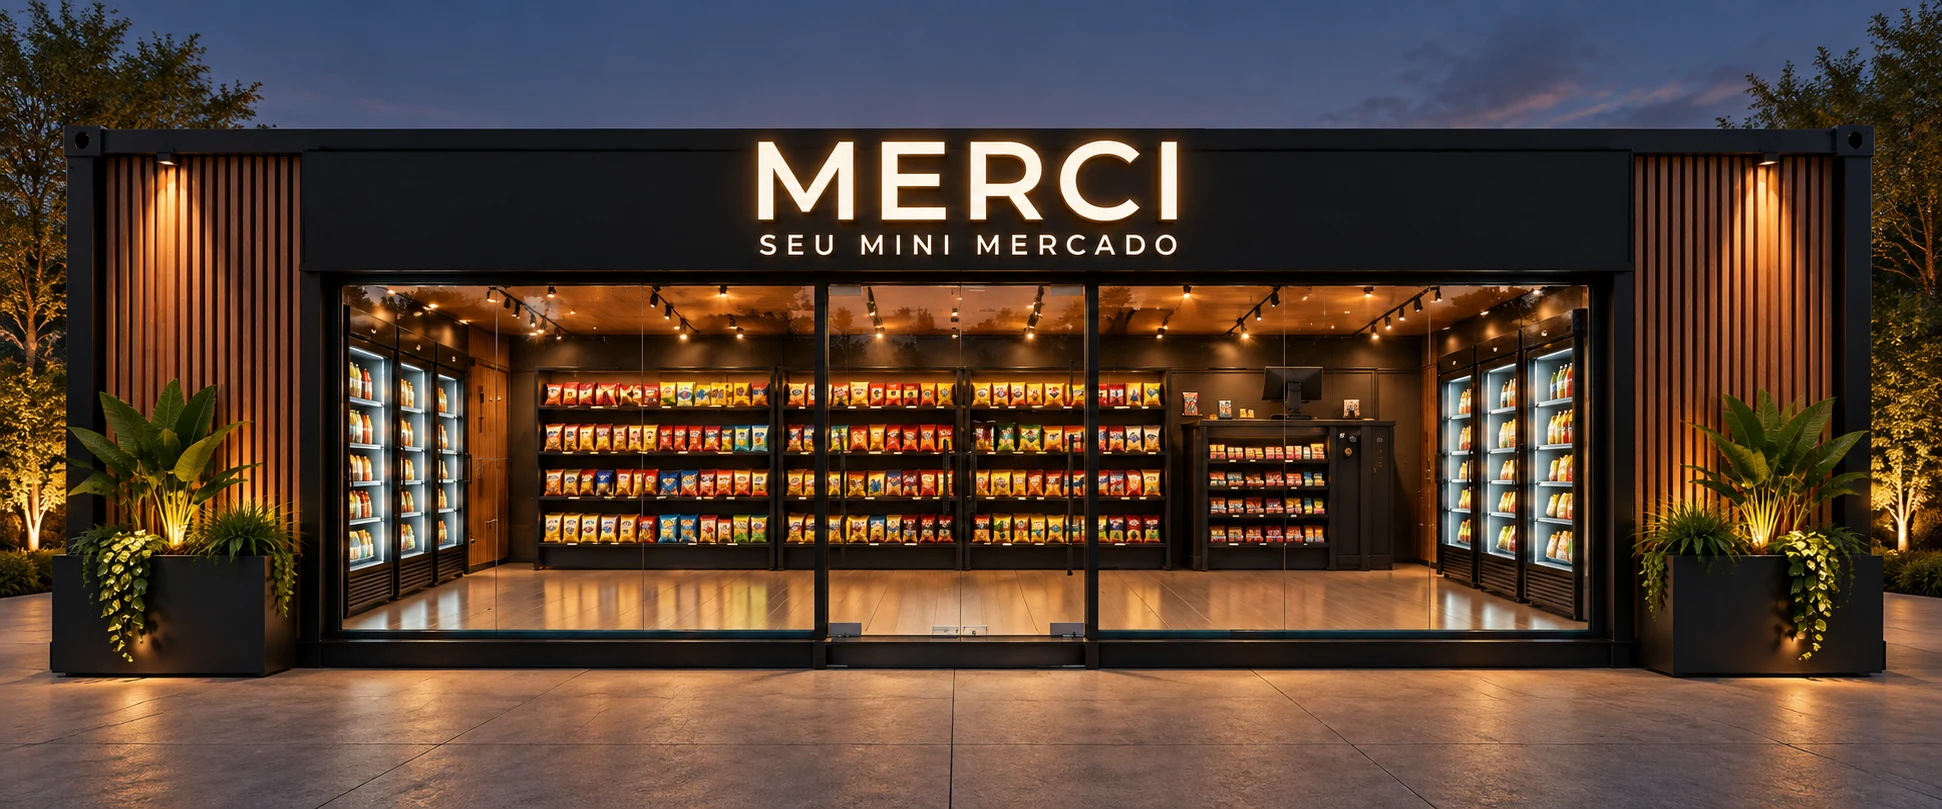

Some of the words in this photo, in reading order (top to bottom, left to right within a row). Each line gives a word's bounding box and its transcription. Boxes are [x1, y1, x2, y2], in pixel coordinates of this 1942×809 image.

[757, 140, 1178, 221] MERCI
[759, 234, 834, 256] SEU
[860, 234, 949, 256] MINI
[977, 234, 1177, 256] MERCADO
